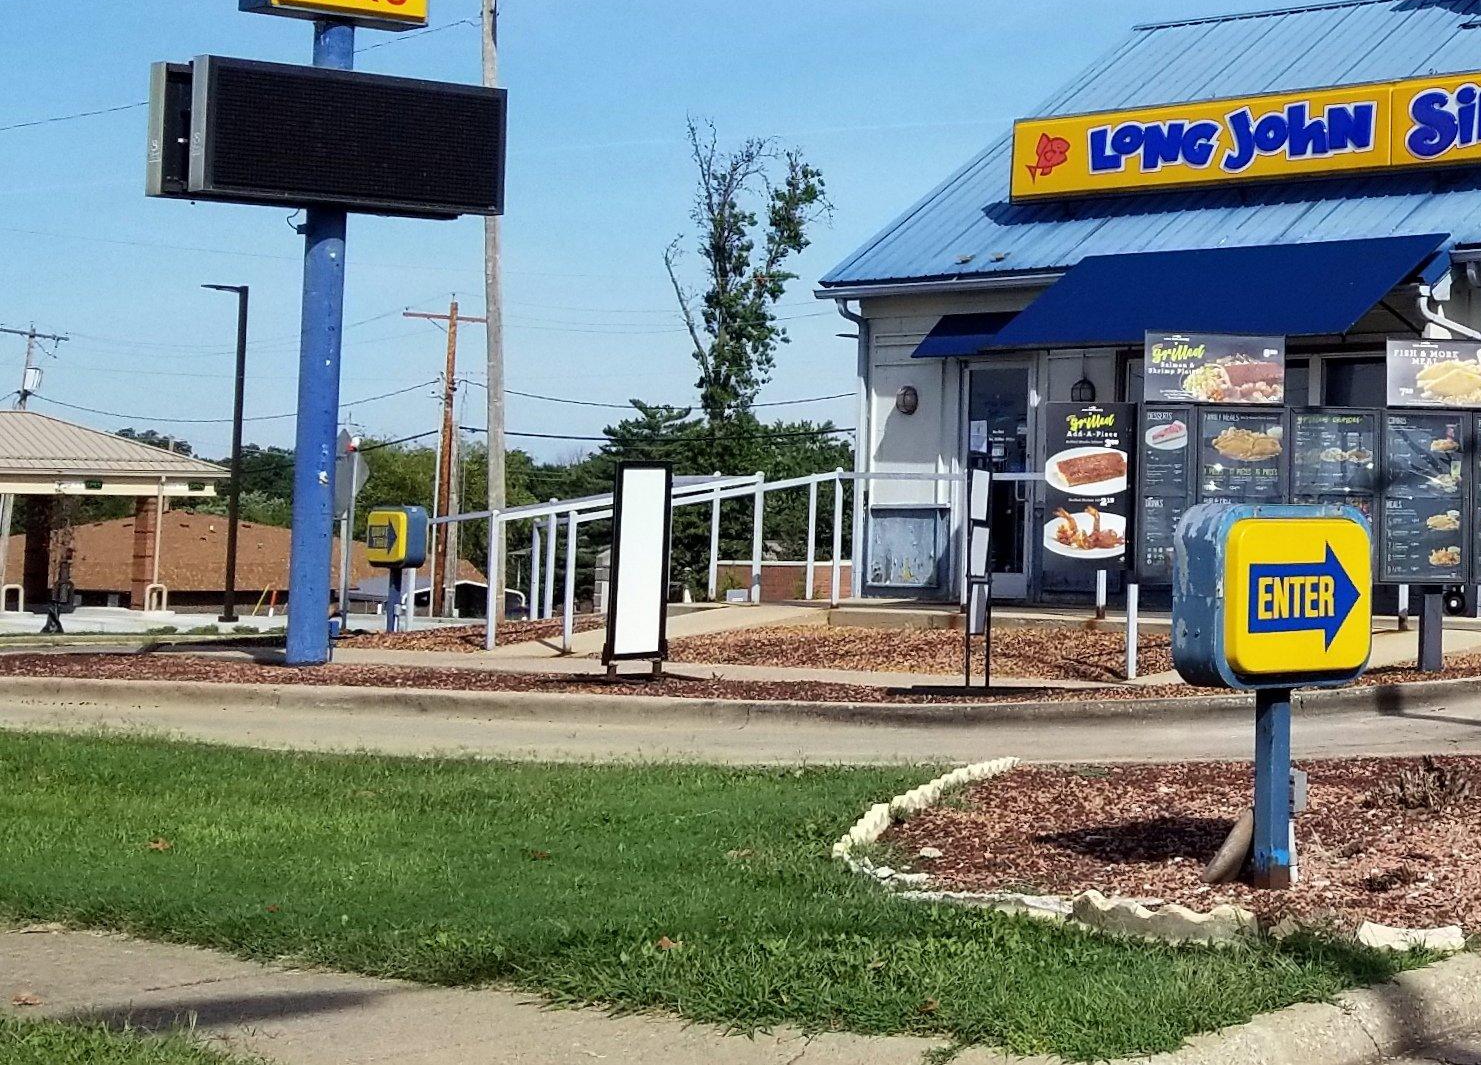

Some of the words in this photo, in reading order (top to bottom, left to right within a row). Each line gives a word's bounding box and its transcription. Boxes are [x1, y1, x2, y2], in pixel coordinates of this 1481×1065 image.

[1394, 349, 1417, 357] FISH
[1429, 350, 1459, 358] MORE
[1257, 575, 1335, 621] ENTER
